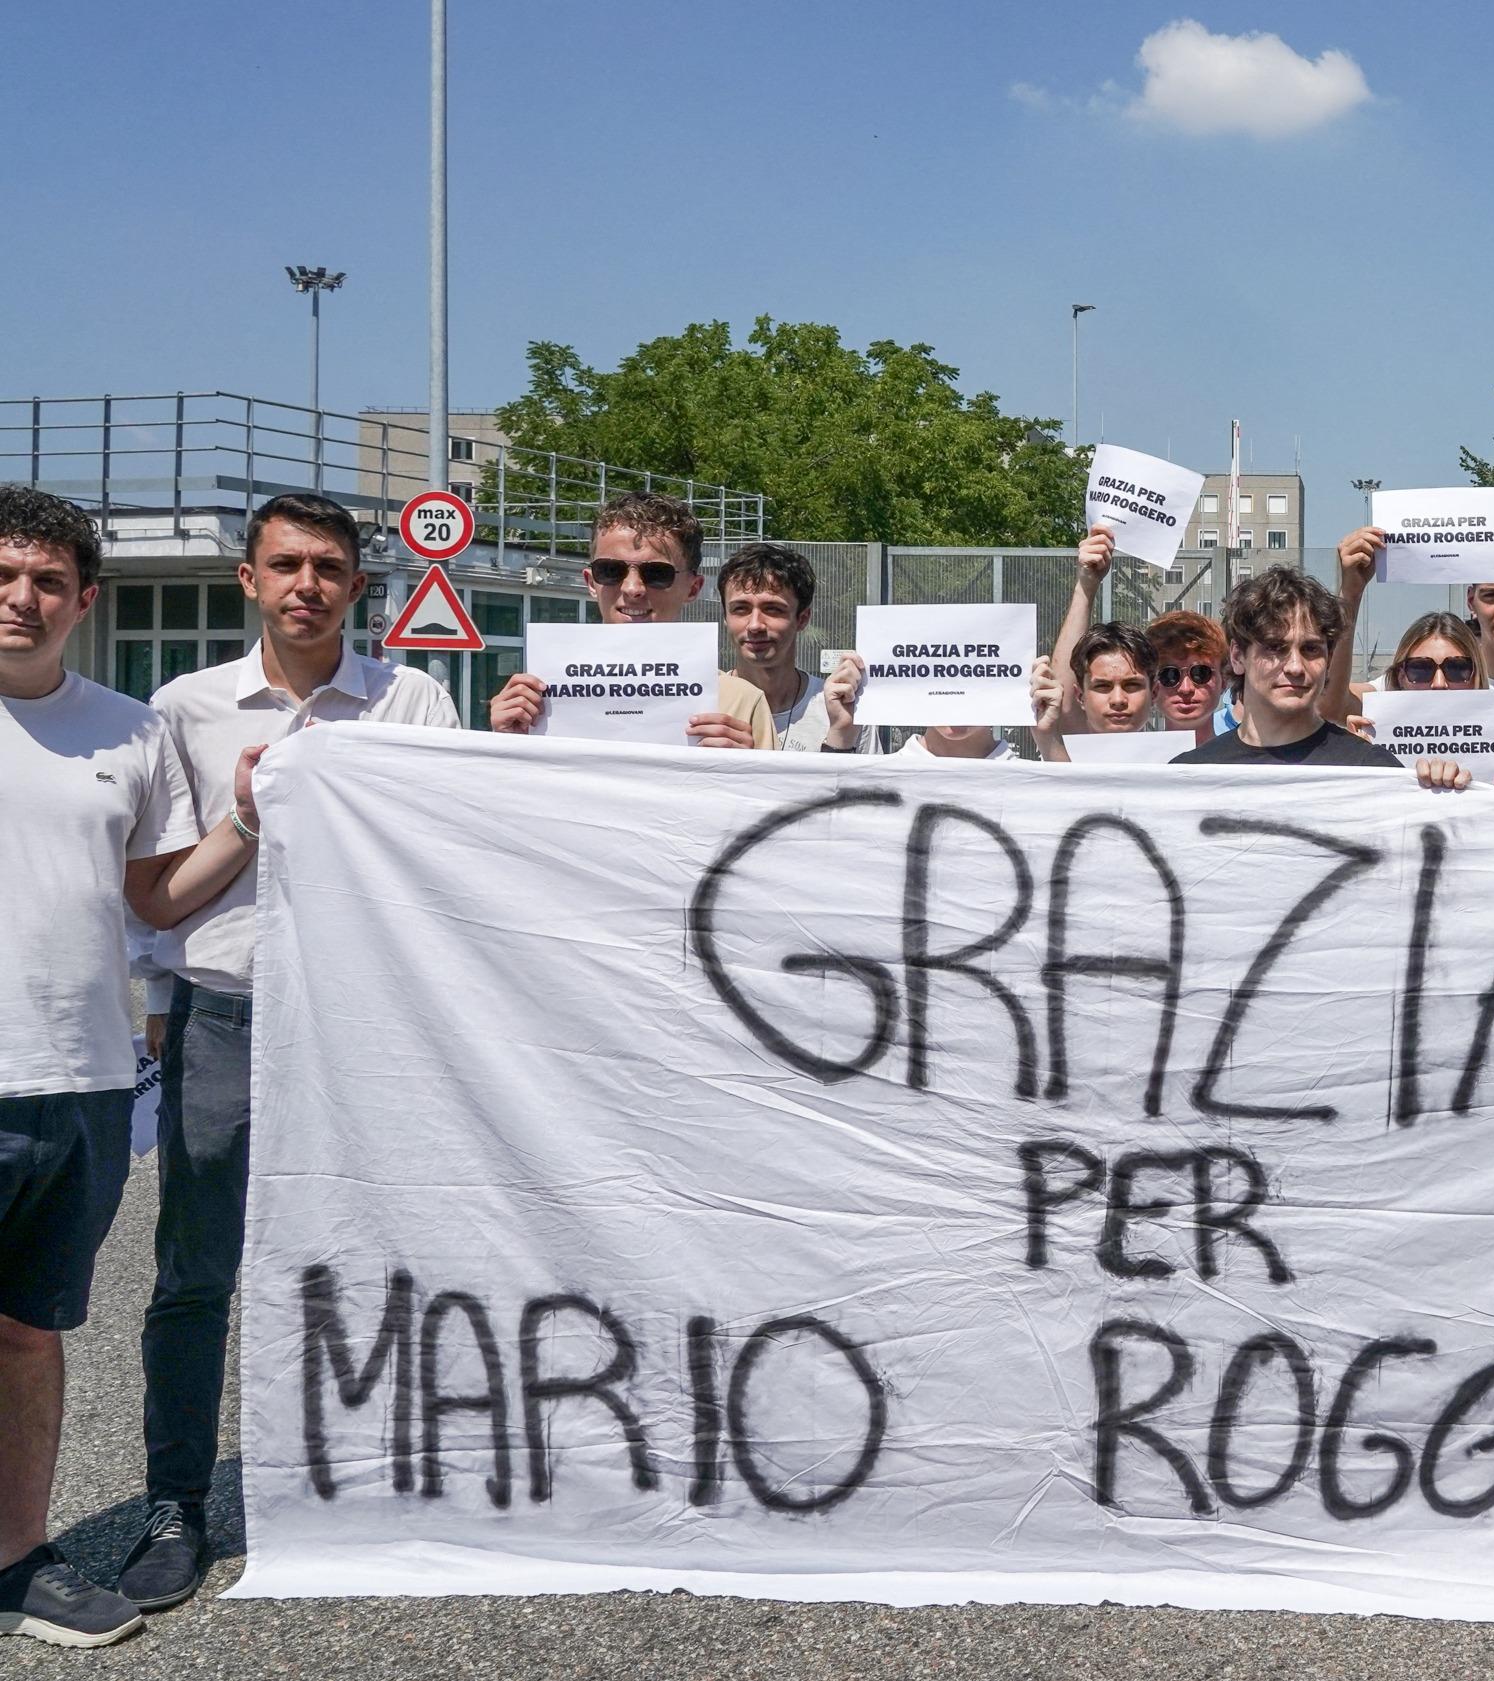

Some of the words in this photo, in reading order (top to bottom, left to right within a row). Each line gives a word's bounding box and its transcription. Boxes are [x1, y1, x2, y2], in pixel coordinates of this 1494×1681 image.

[1098, 476, 1135, 496] GRAZIA
[1137, 487, 1166, 506] PER
[417, 508, 456, 520] max
[1088, 490, 1111, 504] MARIO
[1110, 495, 1177, 527] ROGGERO
[1401, 517, 1455, 528] GRAZIA
[1457, 516, 1487, 527] PER
[423, 523, 451, 542] 20
[1384, 532, 1431, 544] MARIO
[892, 644, 963, 658] GRAZIA
[963, 644, 1000, 657] PER
[565, 663, 640, 678] GRAZIA
[641, 663, 679, 677] PER
[869, 664, 930, 678] MARIO
[933, 664, 1022, 678] ROGGERO
[542, 683, 606, 698] MARIO
[609, 682, 703, 697] ROGGERO
[1392, 725, 1450, 738] GRAZIA
[1452, 725, 1483, 737] PER
[1381, 743, 1424, 755] ARIO
[1015, 1139, 1294, 1285] PER
[297, 1263, 890, 1514] MARIO
